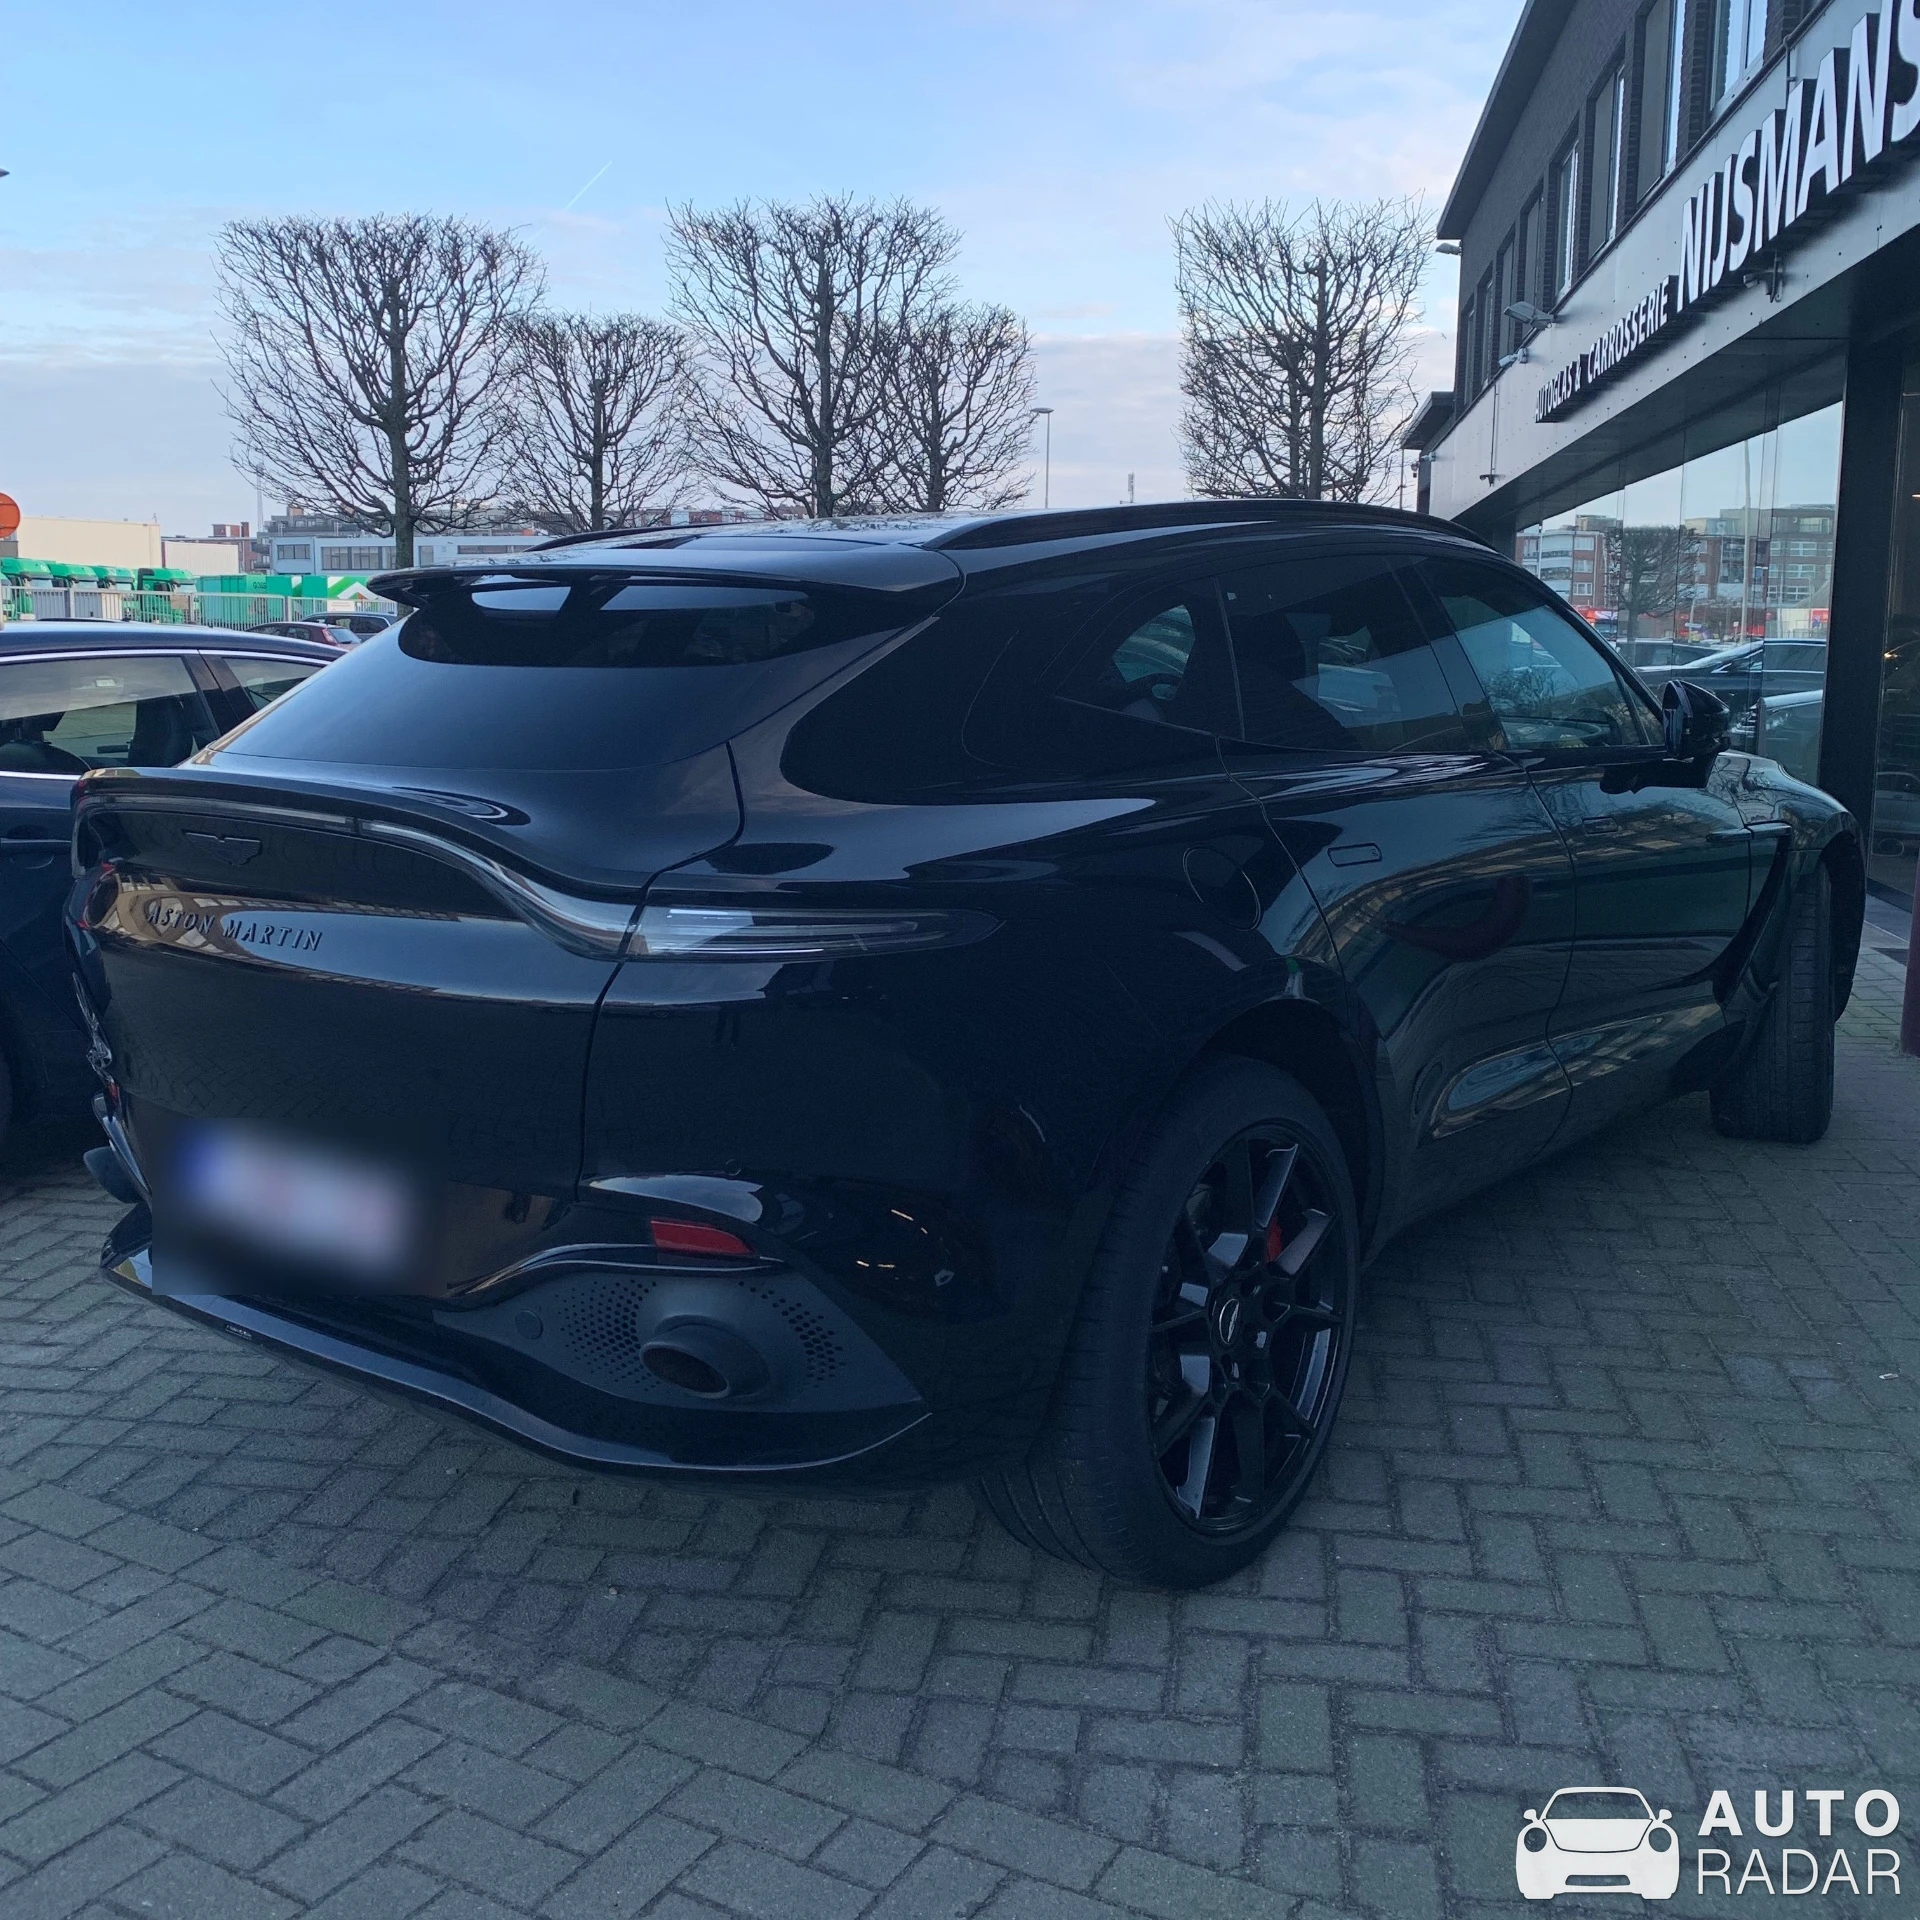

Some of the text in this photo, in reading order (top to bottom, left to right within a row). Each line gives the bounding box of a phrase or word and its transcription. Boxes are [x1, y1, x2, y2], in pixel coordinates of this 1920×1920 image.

[1535, 360, 1574, 422] AUTOGLAS
[1574, 354, 1582, 393] &
[1587, 275, 1670, 384] CARROSSERIE
[147, 904, 323, 952] ASTON MARTIN
